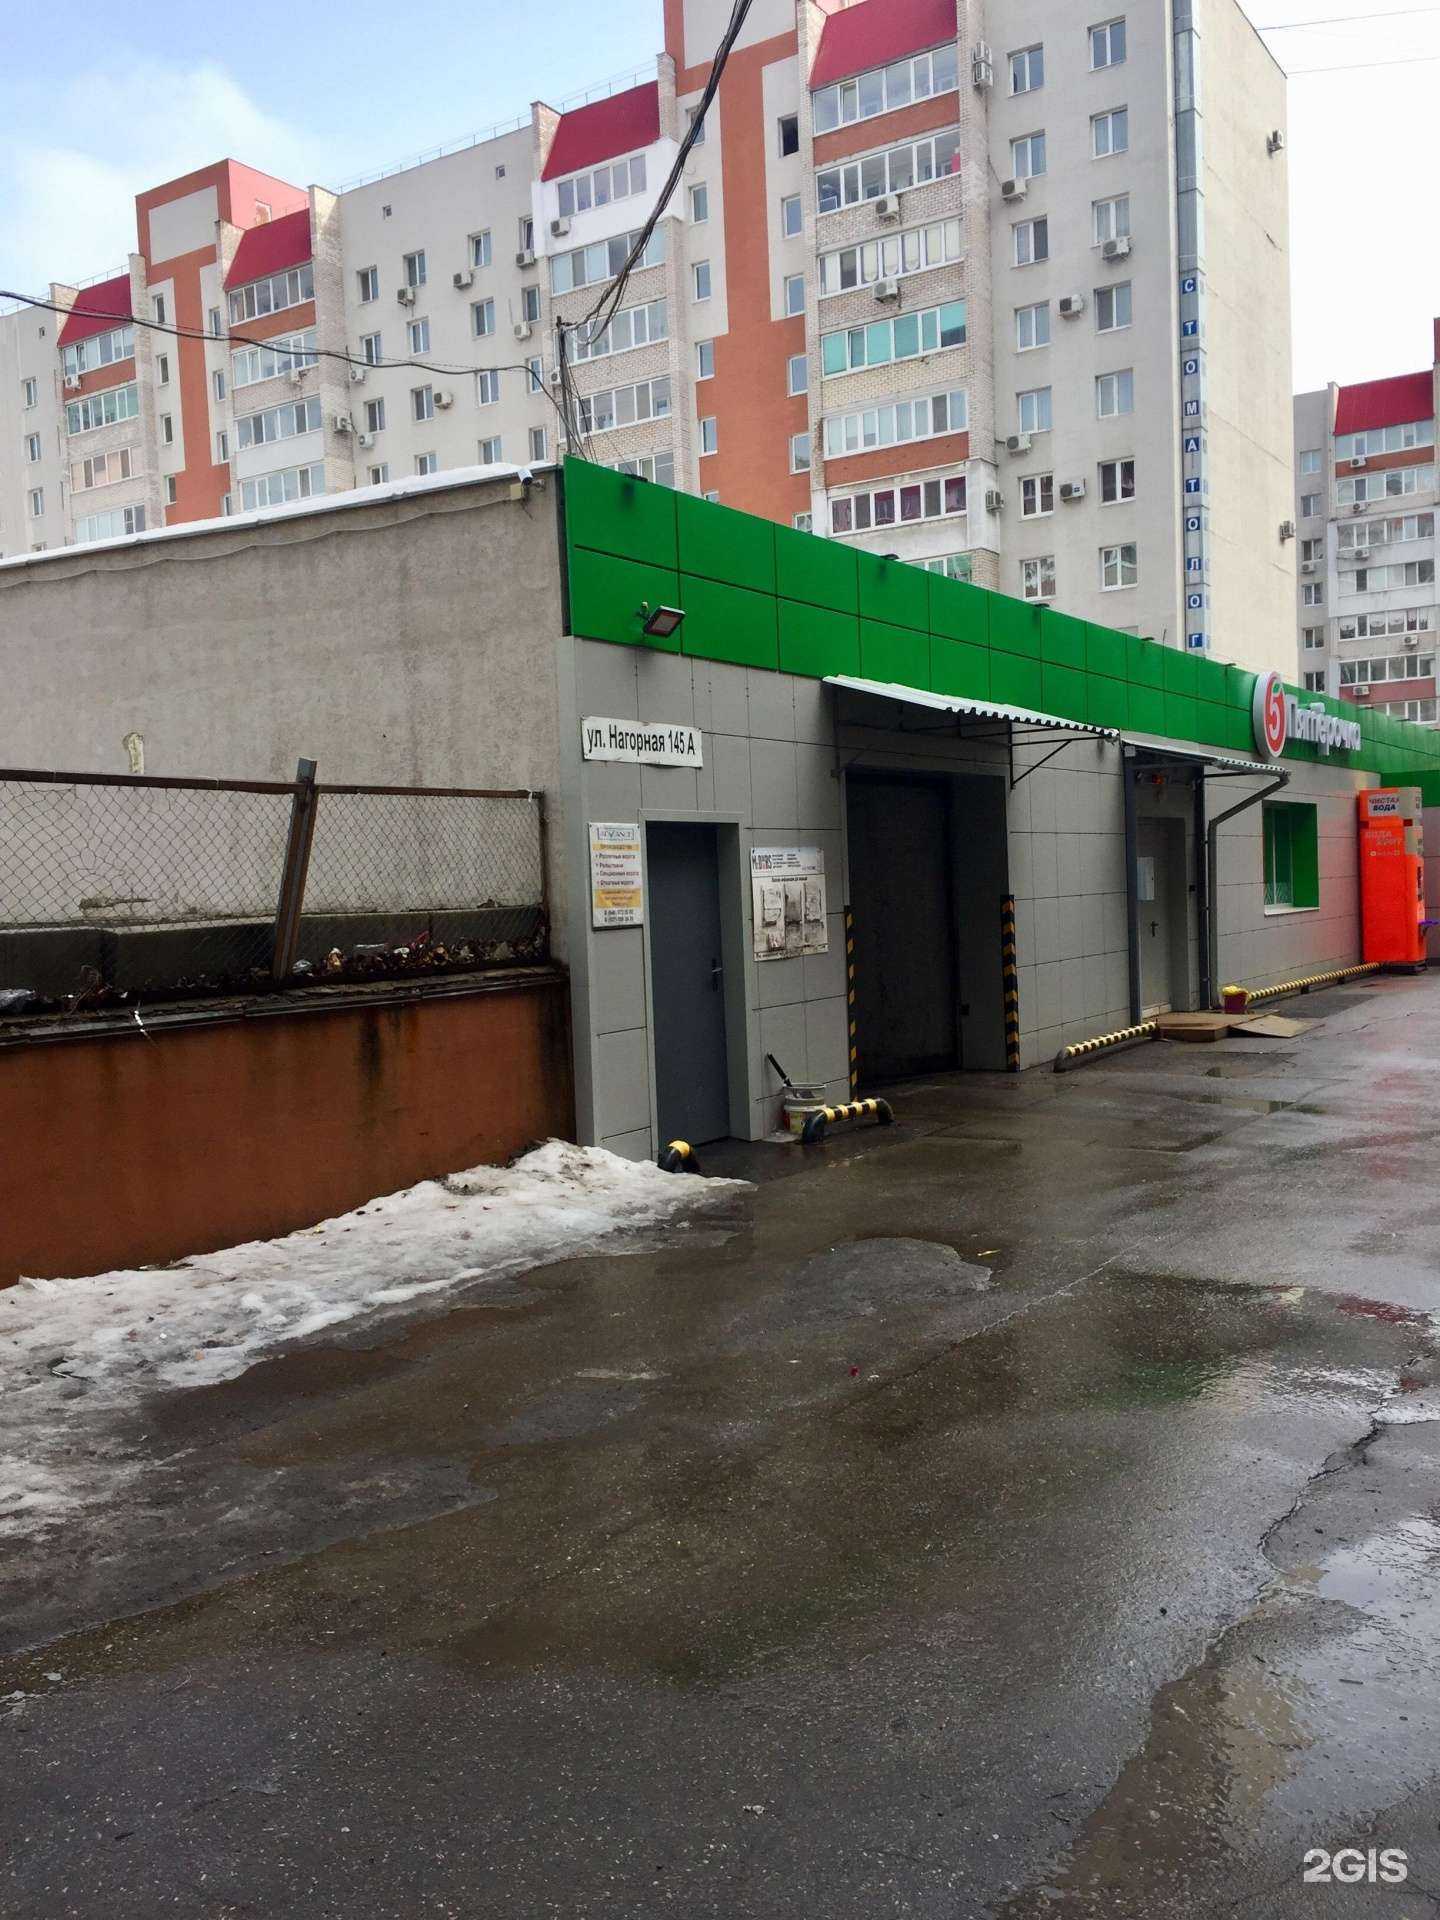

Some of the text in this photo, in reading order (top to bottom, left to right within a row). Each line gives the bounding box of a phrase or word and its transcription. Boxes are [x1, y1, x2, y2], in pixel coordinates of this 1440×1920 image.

[1183, 277, 1202, 649] СТОМАТОЛОГ
[587, 724, 695, 756] ул. Нагорная 145 А
